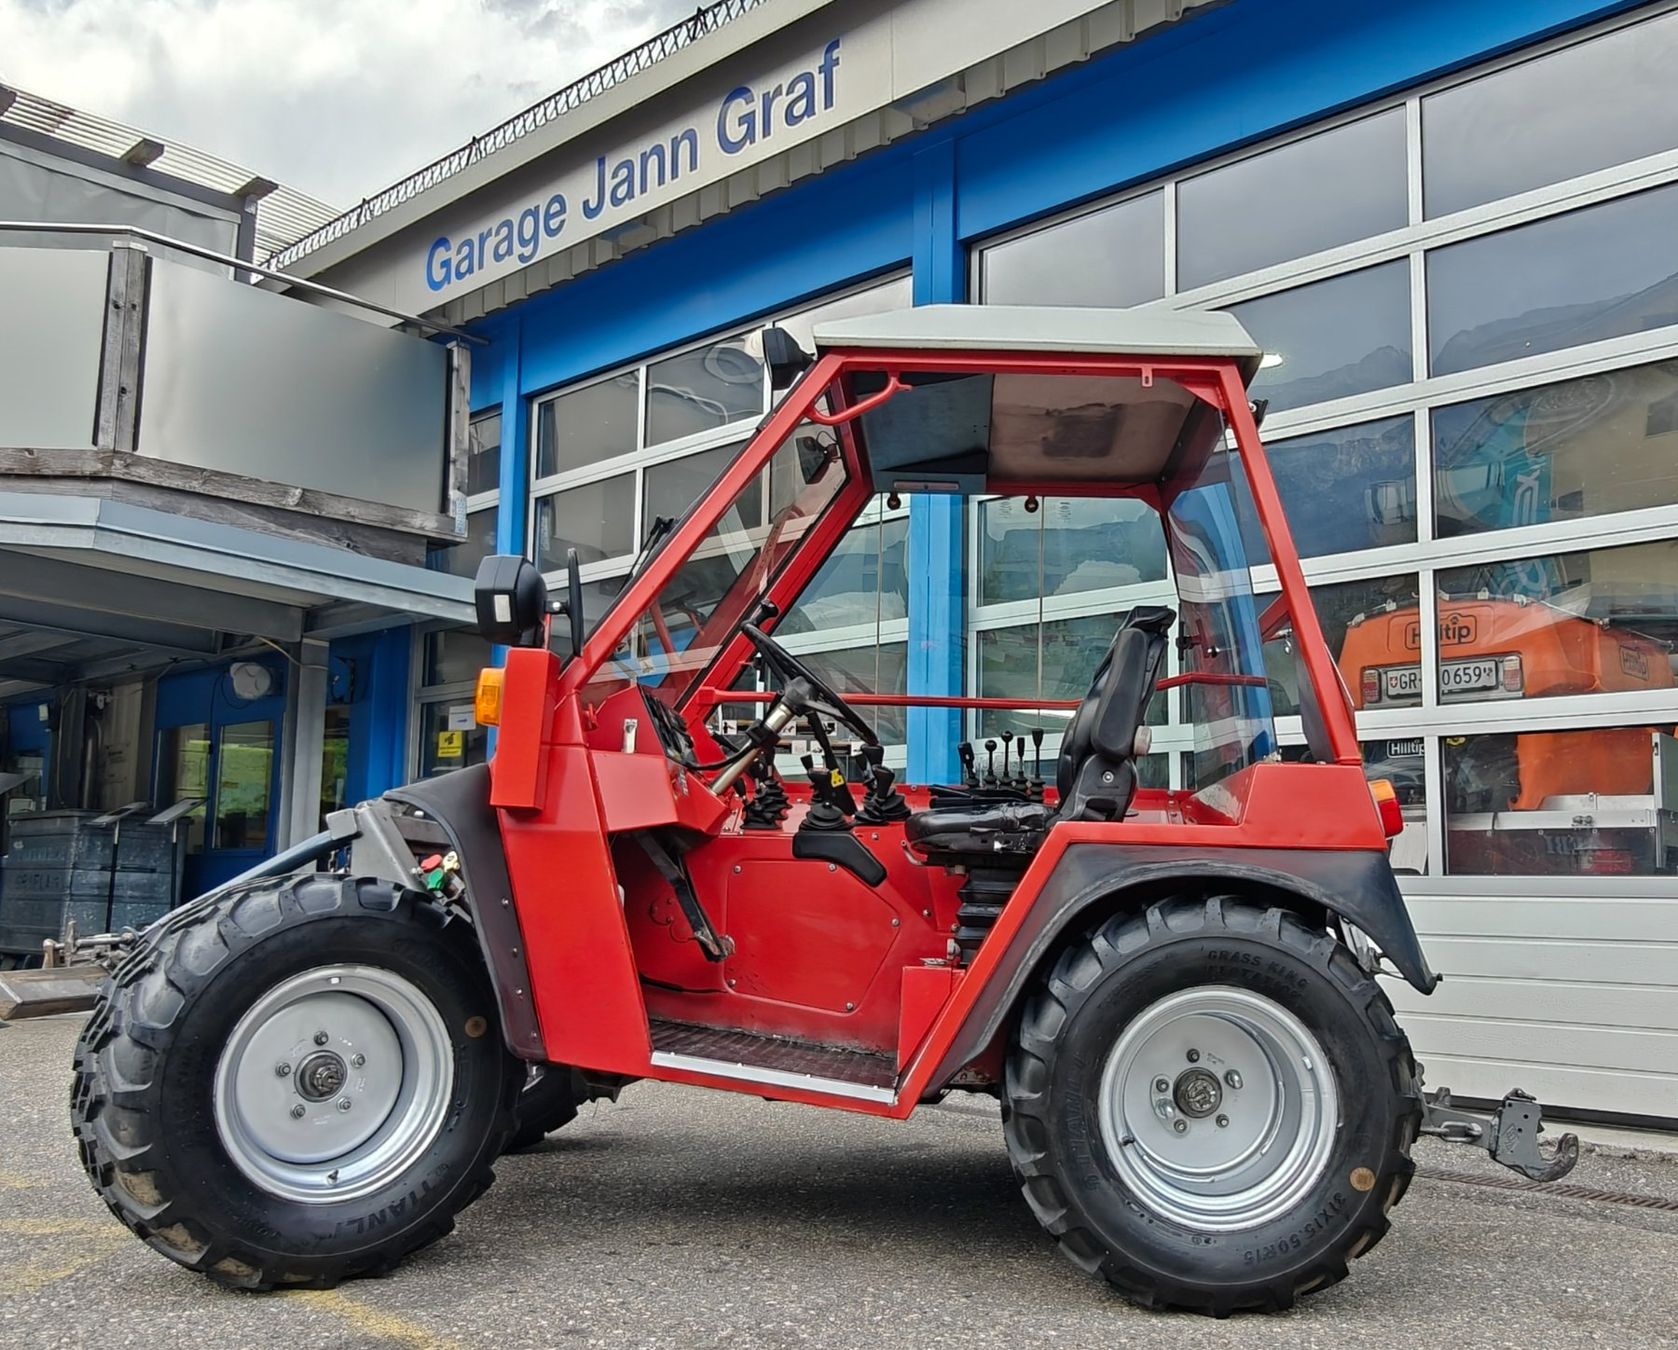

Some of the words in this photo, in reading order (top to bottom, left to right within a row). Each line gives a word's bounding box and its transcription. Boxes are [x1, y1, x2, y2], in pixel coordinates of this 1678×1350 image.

[425, 193, 567, 292] Garage
[582, 126, 699, 221] Jann
[716, 38, 842, 156] Graf
[1207, 950, 1261, 967] GRASS
